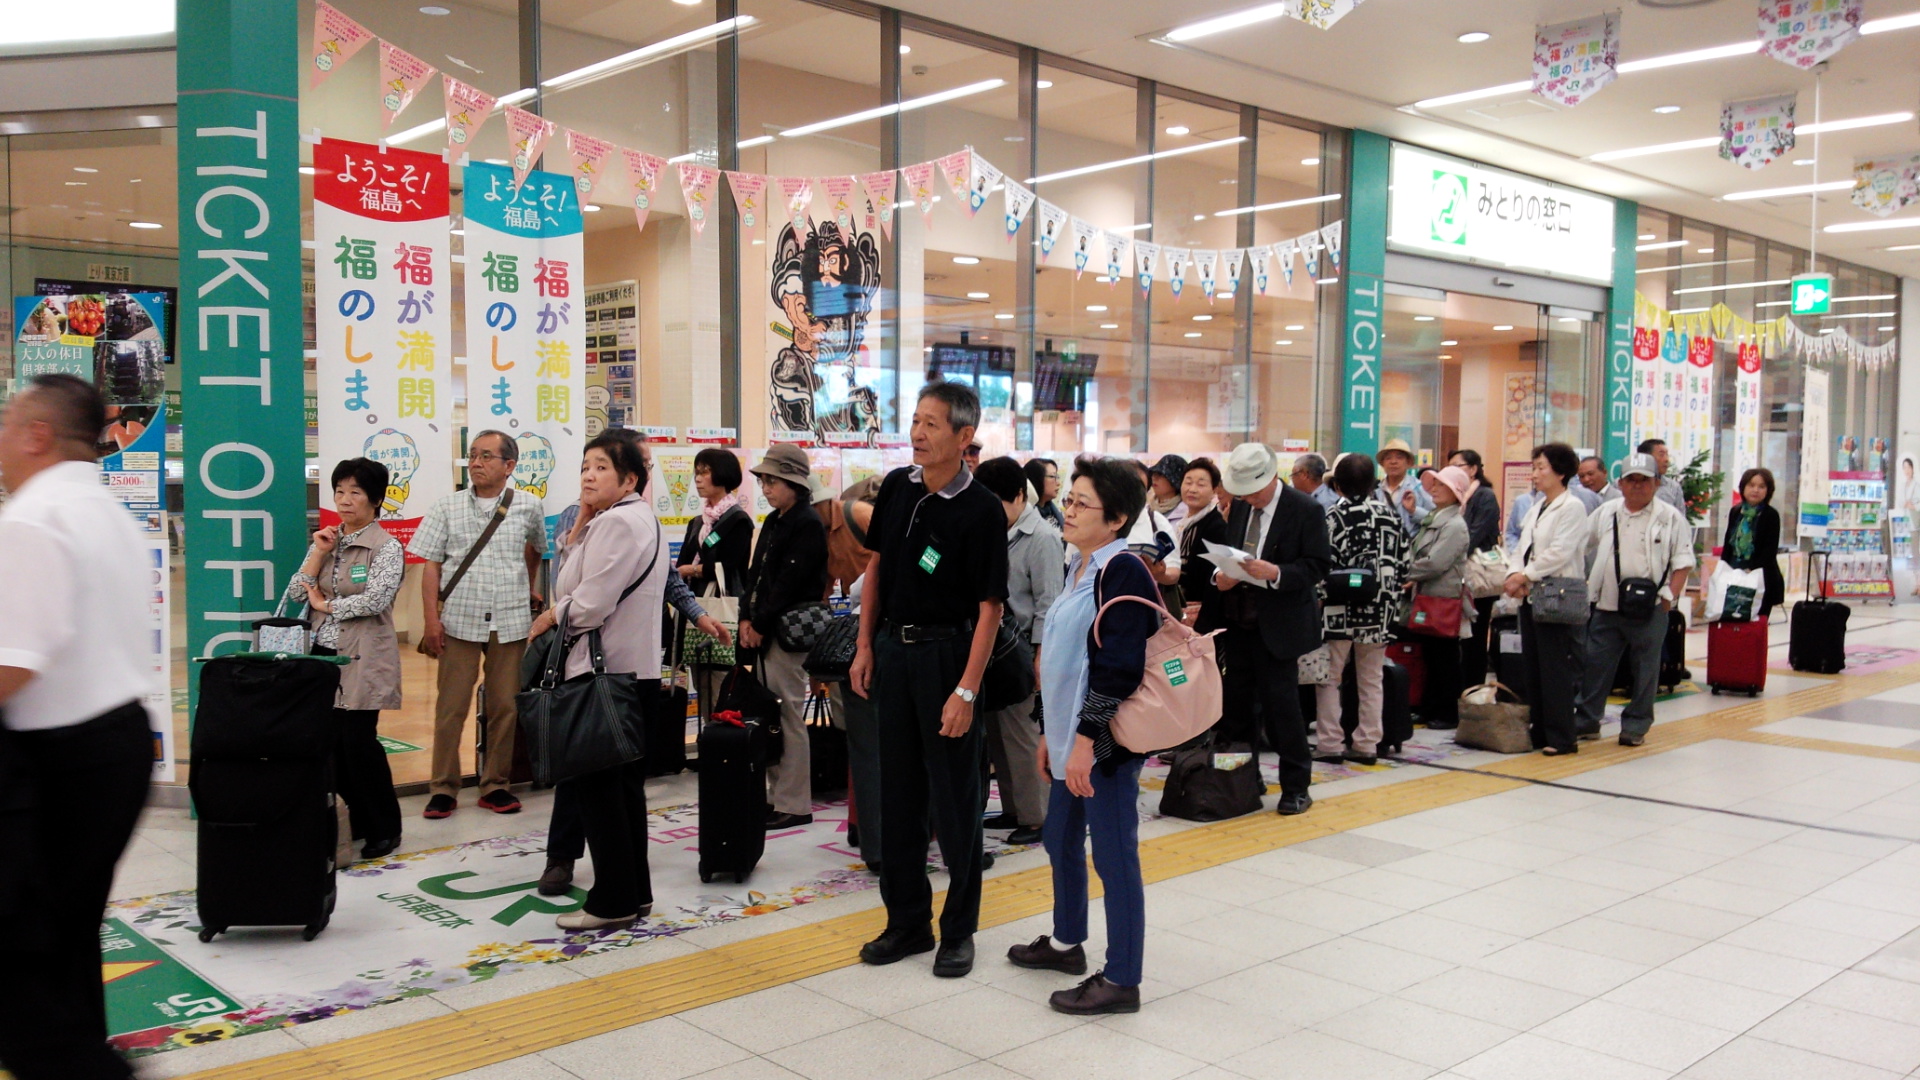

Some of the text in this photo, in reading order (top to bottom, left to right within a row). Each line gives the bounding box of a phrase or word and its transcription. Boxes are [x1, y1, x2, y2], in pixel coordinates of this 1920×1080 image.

[359, 188, 422, 214] 福島へ
[503, 206, 559, 231] 福島へ
[195, 111, 271, 406] TICKET
[21, 347, 82, 361] 大人の休日
[334, 235, 378, 424] 福のしま。
[393, 242, 438, 432] 福が満開、
[481, 250, 519, 429] 福のしま。
[534, 257, 573, 436] 福が満開、
[1350, 280, 1379, 439] TICKET
[1611, 317, 1632, 446] TICKET
[385, 460, 411, 471] のしま。
[521, 449, 551, 460] が満開、
[376, 890, 474, 929] JR東日本
[167, 993, 227, 1017] JR
